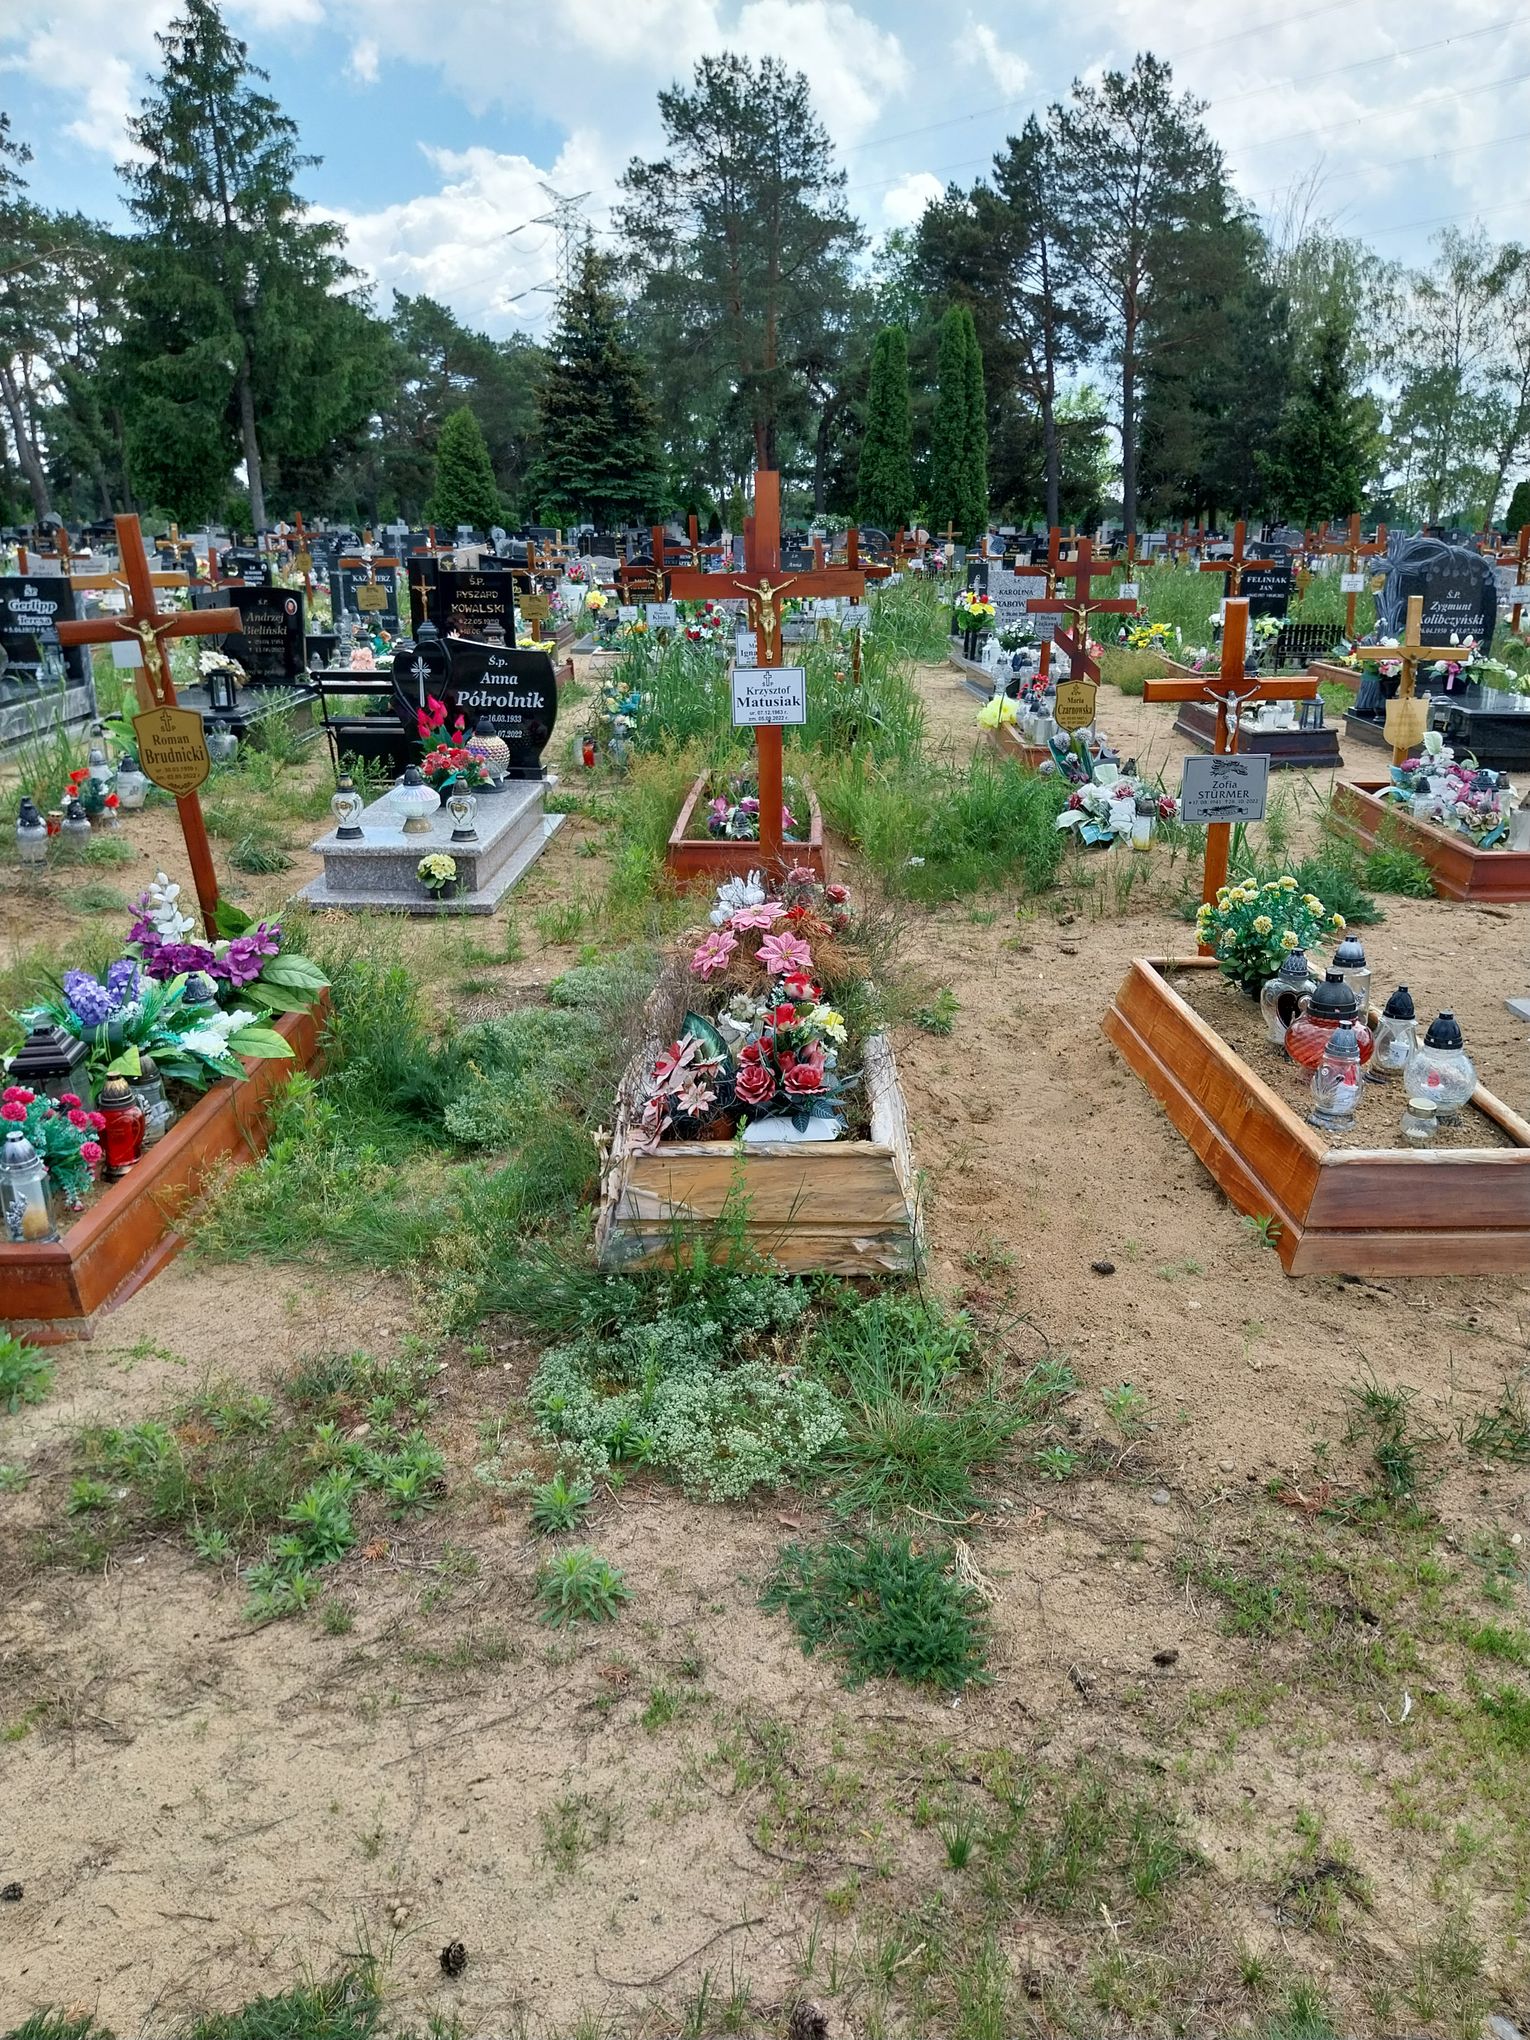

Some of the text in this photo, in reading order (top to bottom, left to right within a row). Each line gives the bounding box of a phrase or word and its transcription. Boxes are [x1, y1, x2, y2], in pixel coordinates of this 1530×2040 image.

[456, 590, 498, 599] RYSZARD
[1446, 589, 1460, 599] Ś.P.
[8, 598, 58, 614] Gerlipp
[451, 603, 505, 613] KOWALSKI
[1430, 601, 1472, 612] Zygmunt
[18, 613, 53, 626] Teresa
[246, 612, 284, 623] Andrzej
[488, 655, 508, 667] Ś.p.
[480, 672, 518, 684] Anna
[746, 686, 791, 697] Krzysztof
[455, 691, 545, 708] Półrolnik
[737, 696, 801, 708] Matusiak
[152, 734, 190, 746] Roman
[145, 745, 204, 764] Brudnicki
[1212, 781, 1237, 789] Zofia
[1198, 789, 1250, 799] STÜRMER
